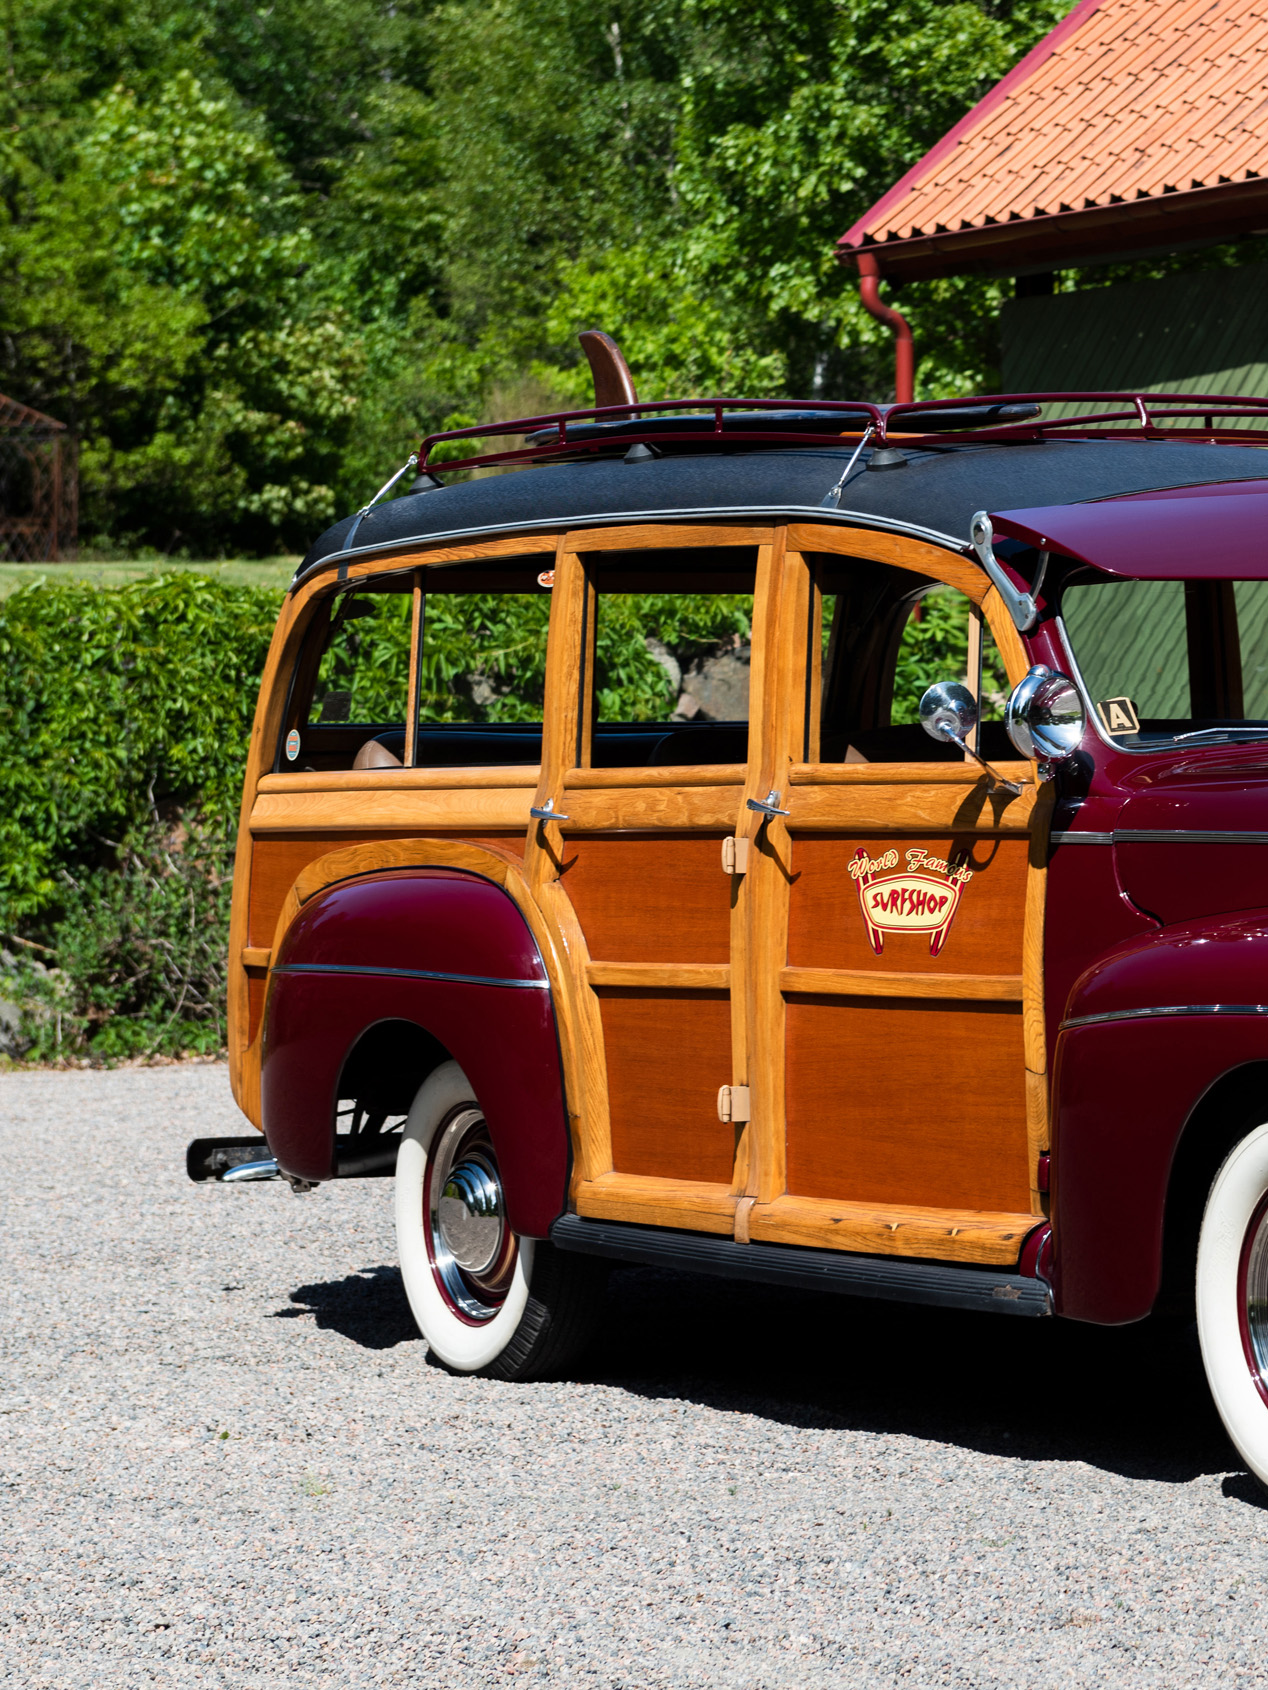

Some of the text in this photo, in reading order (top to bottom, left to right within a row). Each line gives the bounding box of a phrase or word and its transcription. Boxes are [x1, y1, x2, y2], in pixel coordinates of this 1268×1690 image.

[1109, 703, 1133, 728] A
[848, 849, 973, 882] World Famous
[871, 888, 949, 916] SURFSHOP
